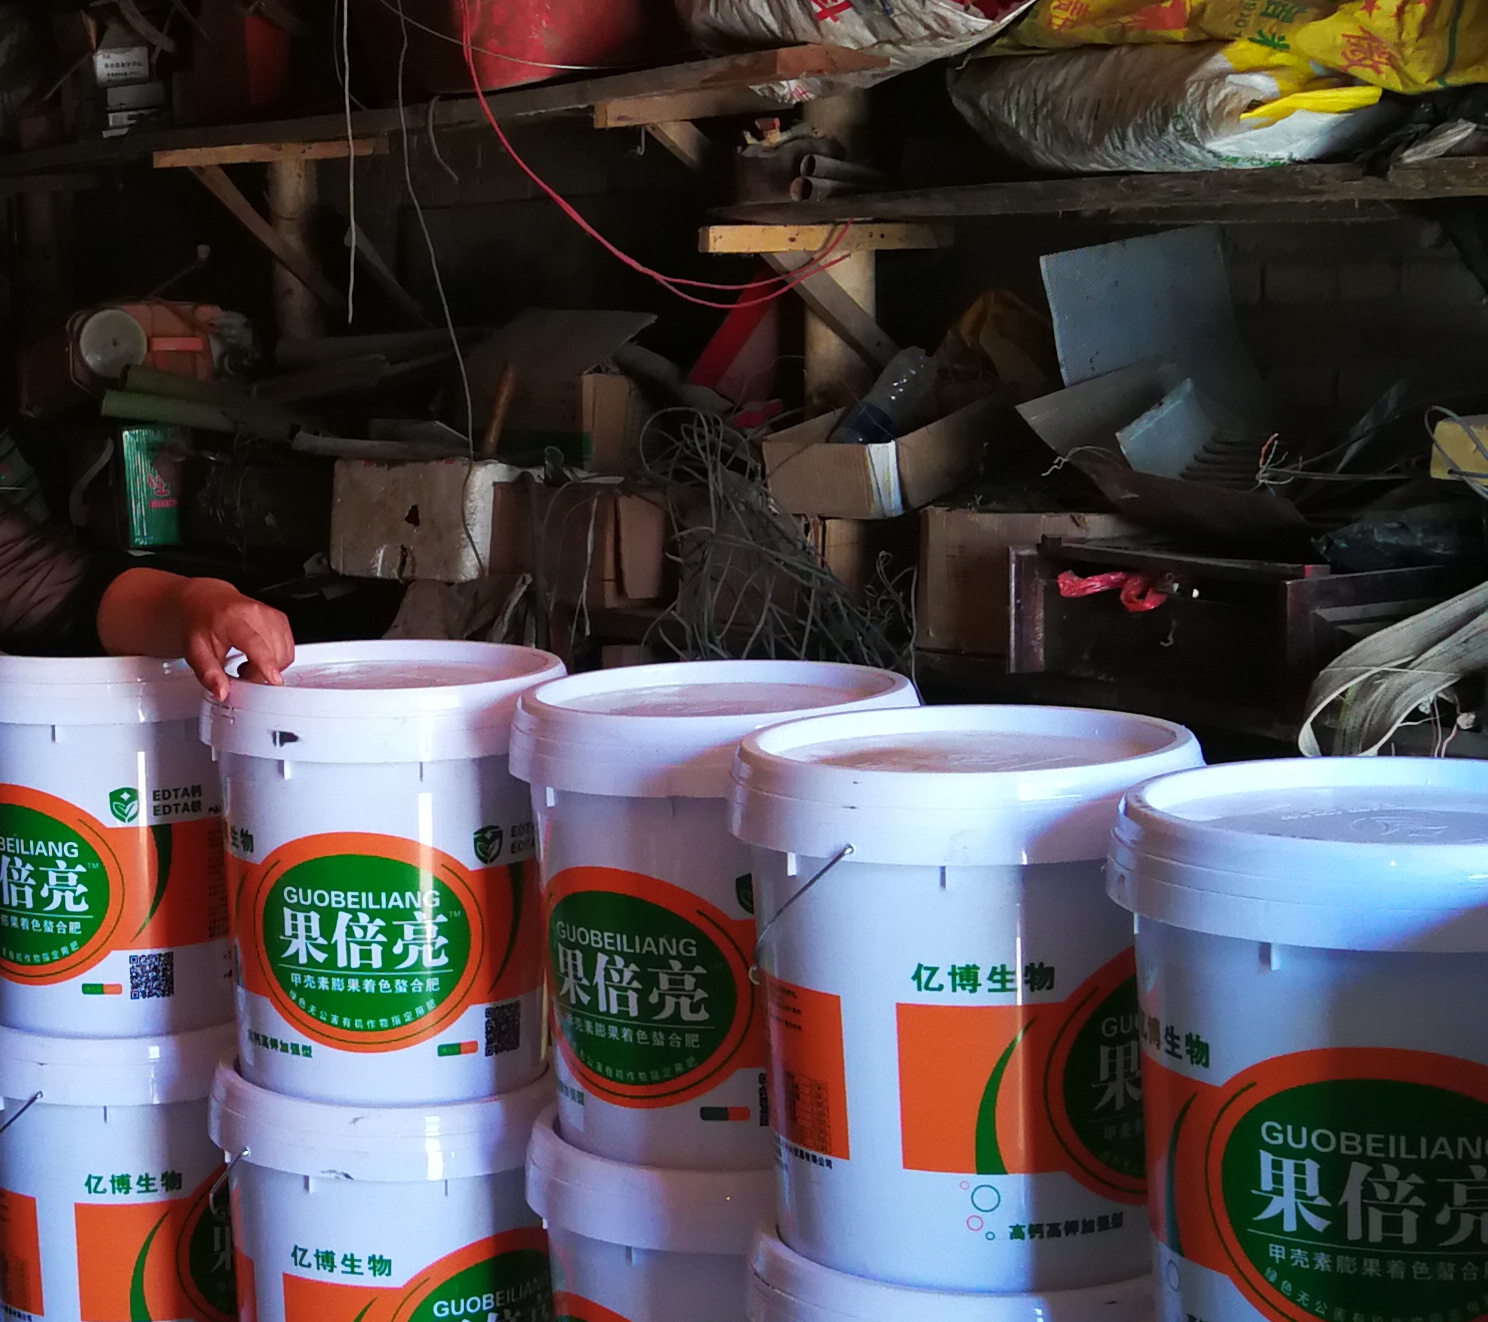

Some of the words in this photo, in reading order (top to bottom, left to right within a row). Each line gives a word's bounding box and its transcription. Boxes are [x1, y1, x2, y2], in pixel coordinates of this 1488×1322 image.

[284, 887, 440, 909] GUOBEILIANG
[279, 907, 449, 970] 果倍亮
[556, 921, 697, 957] GUOBEILIANG
[291, 972, 440, 993] 甲壳素膨果着色螯合肥
[558, 943, 710, 1022] 果倍亮
[911, 962, 1055, 994] 亿博生物
[84, 1170, 183, 1195] 亿博生物
[291, 1245, 392, 1277] 亿博生物
[1268, 1243, 1488, 1281] 甲壳素膨果着色螯合
